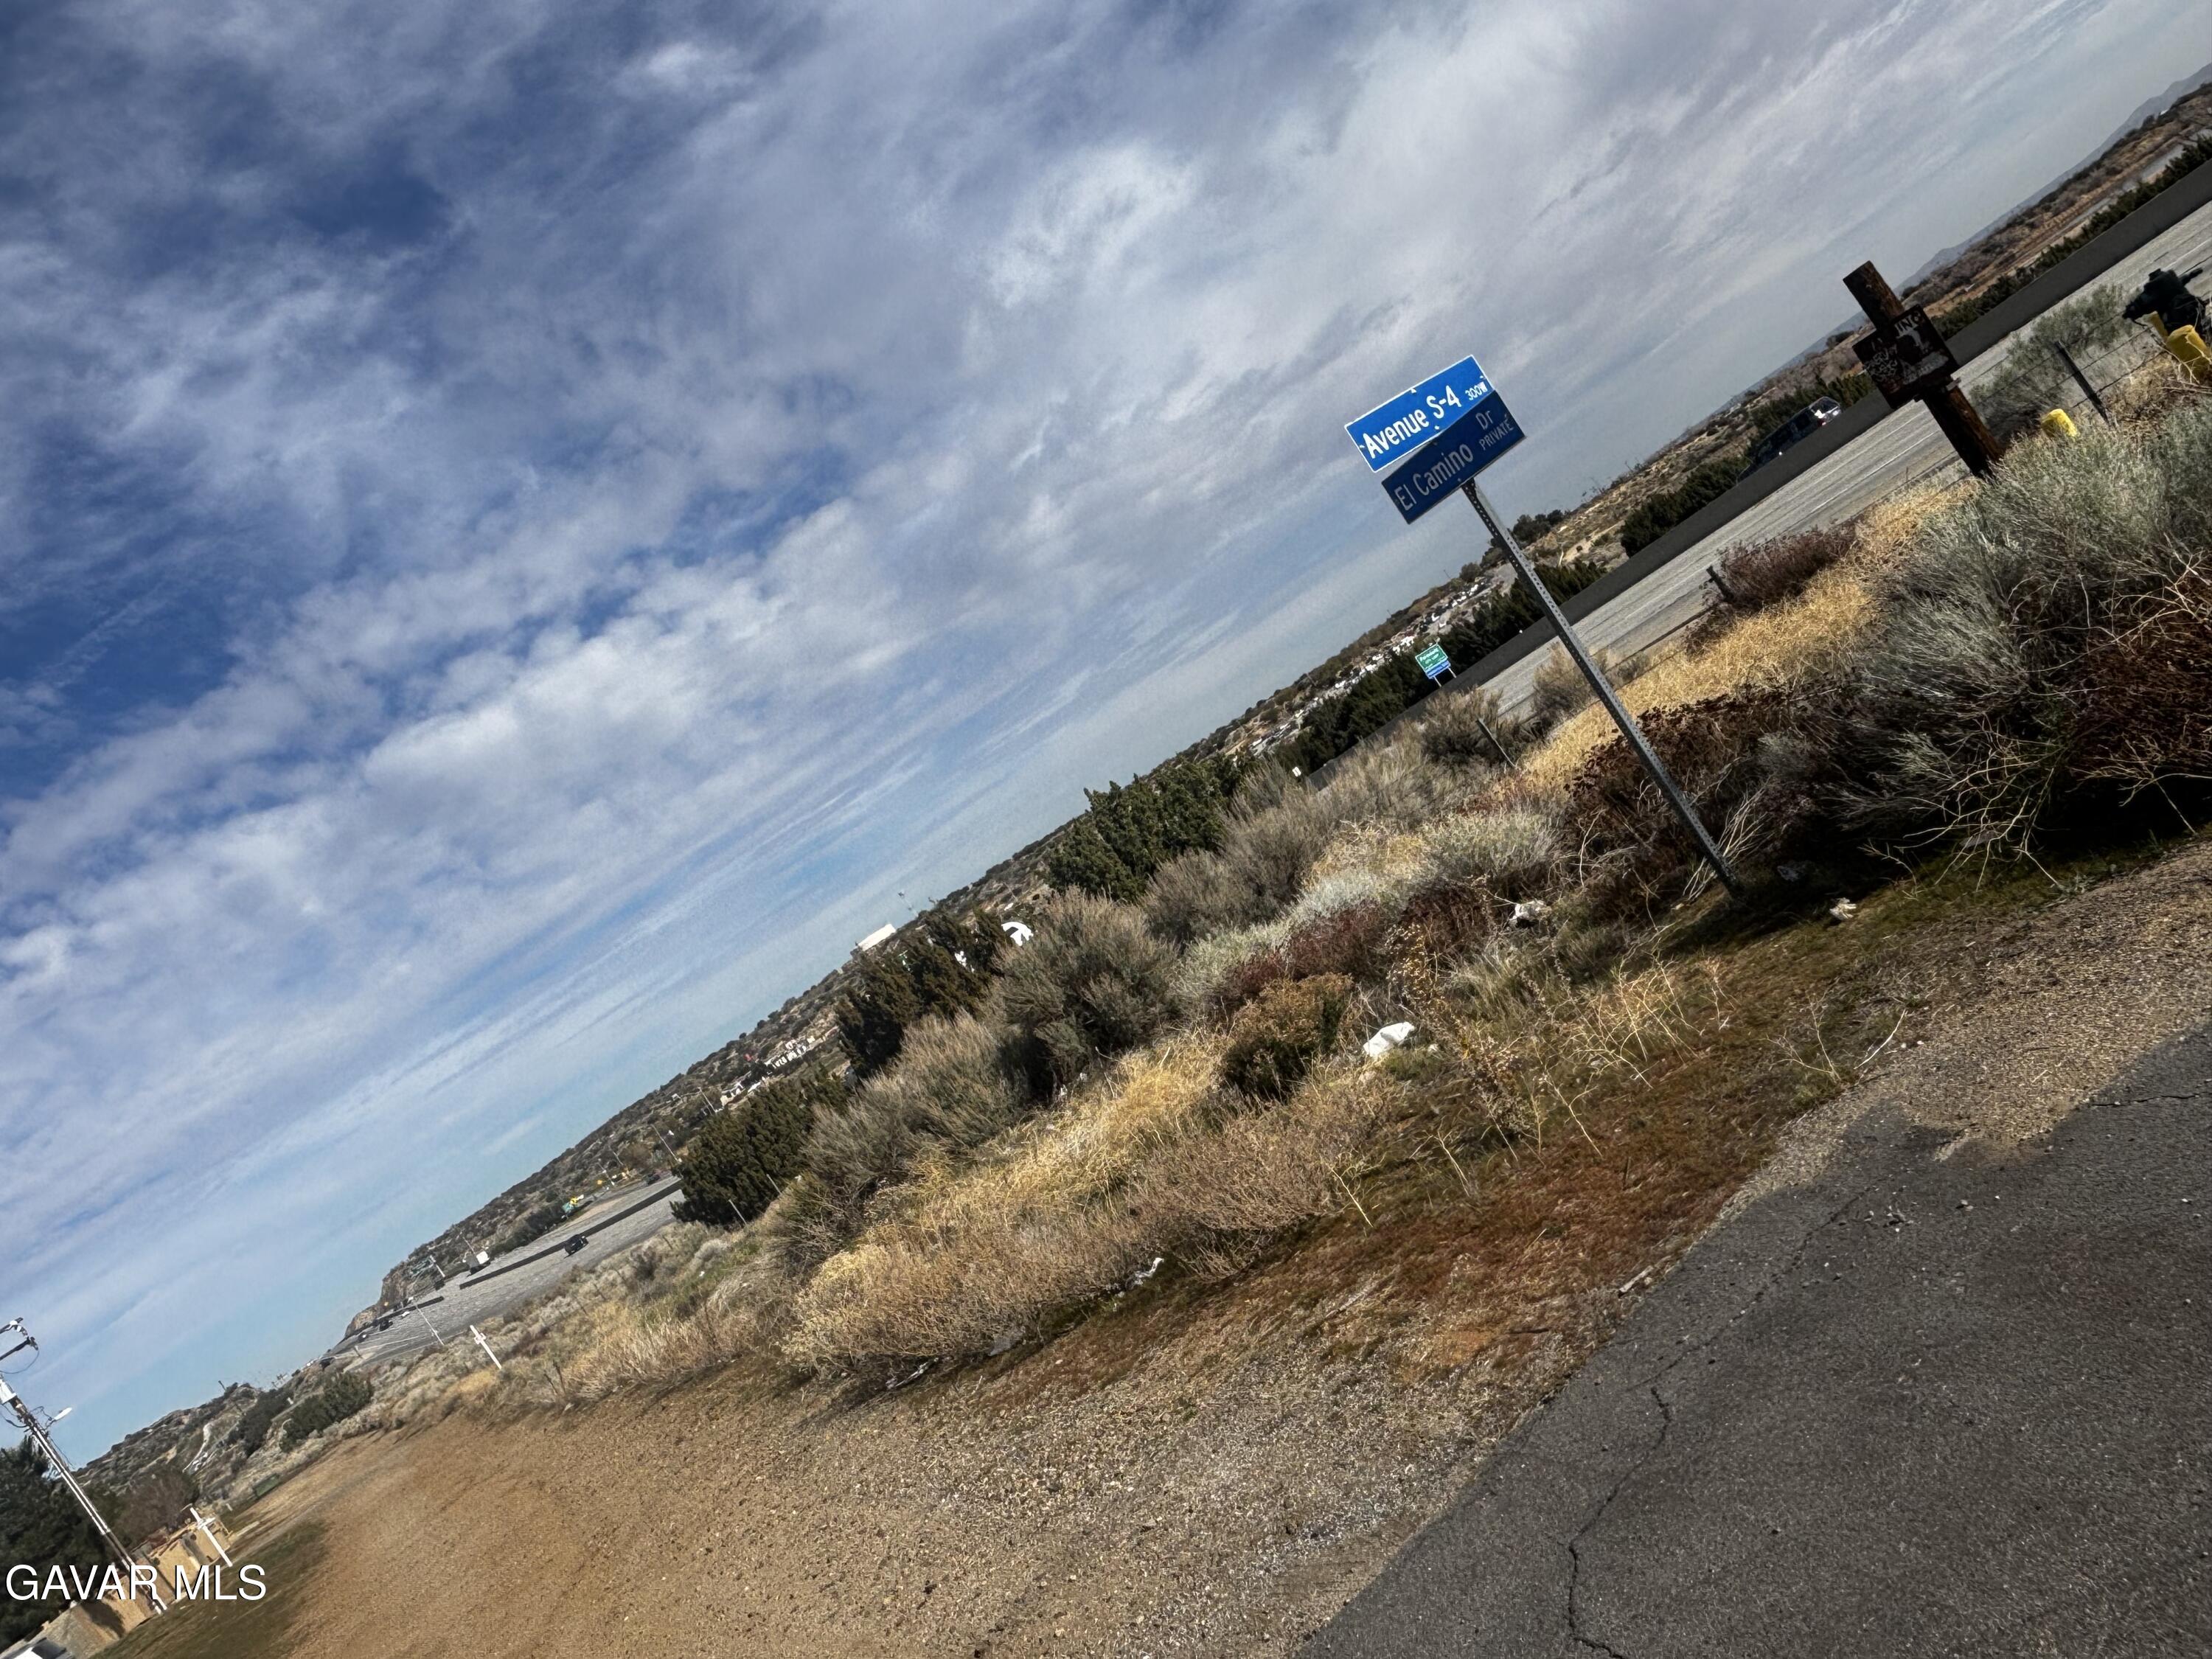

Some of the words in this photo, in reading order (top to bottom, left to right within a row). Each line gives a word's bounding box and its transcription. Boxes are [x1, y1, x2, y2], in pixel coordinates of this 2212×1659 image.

[1363, 409, 1429, 459] Avenue
[1427, 385, 1461, 419] S-4
[1479, 420, 1514, 451] PRIVATE
[1395, 484, 1416, 510] El
[1413, 444, 1473, 495] Camino
[1476, 411, 1493, 430] Dr
